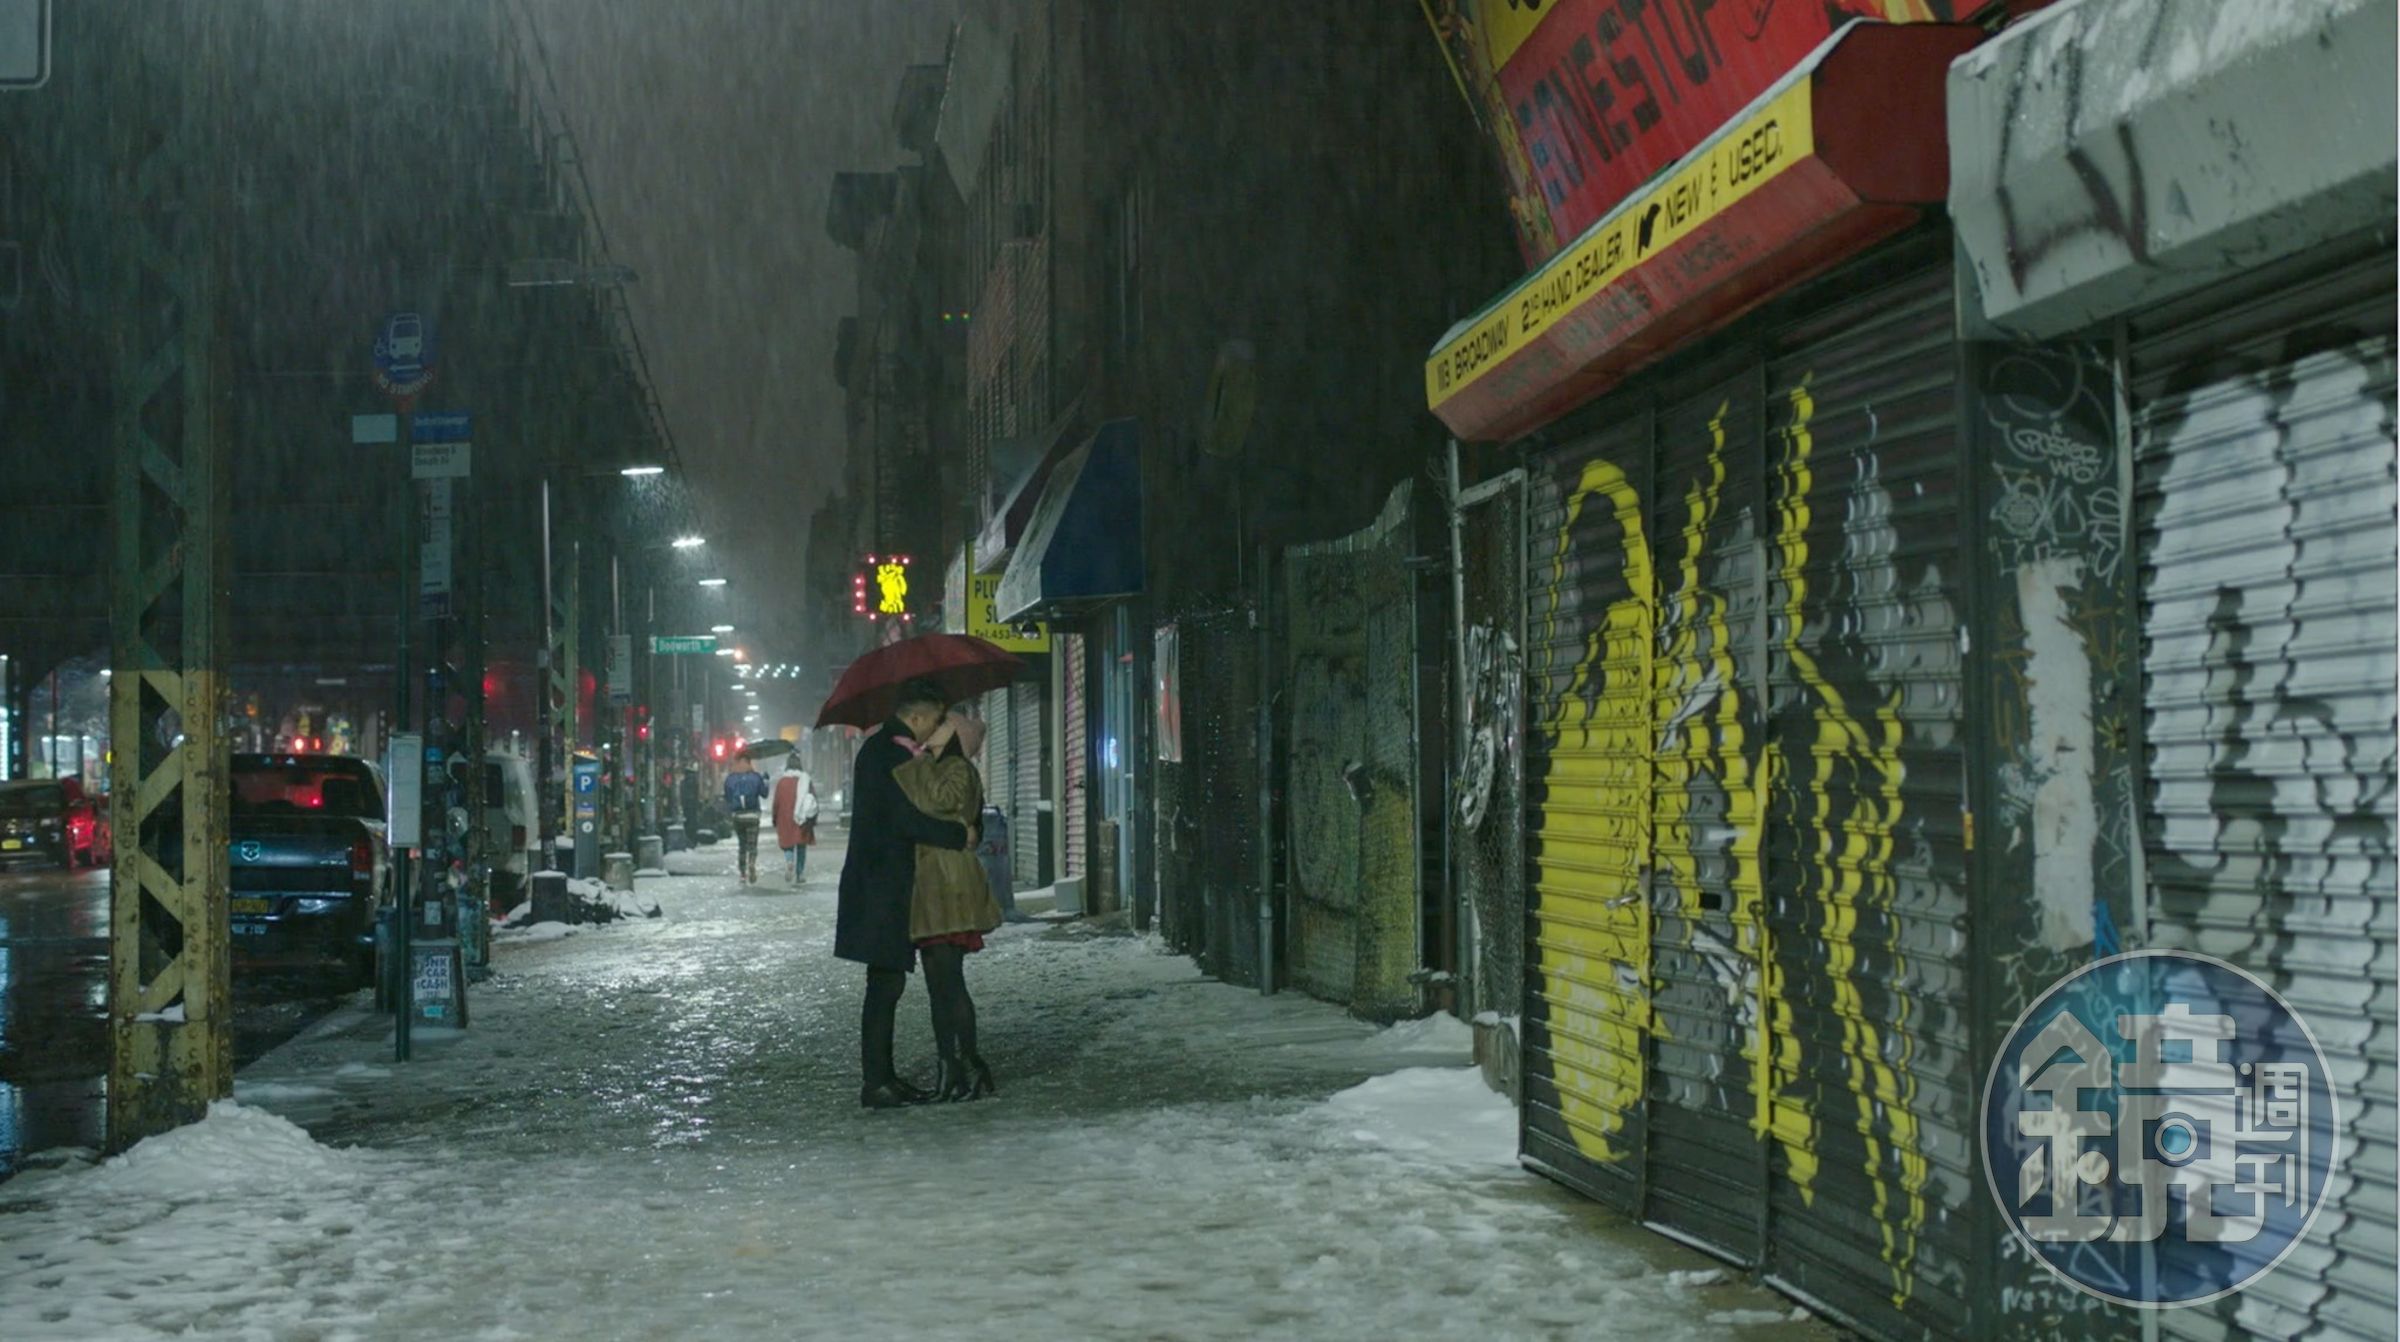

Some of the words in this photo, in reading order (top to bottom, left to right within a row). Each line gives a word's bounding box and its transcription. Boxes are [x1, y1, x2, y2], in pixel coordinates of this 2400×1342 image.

[1455, 315, 1510, 380] BROADWAY
[1542, 271, 1572, 315] HAND
[1664, 173, 1702, 234] NEW
[580, 775, 592, 792] P
